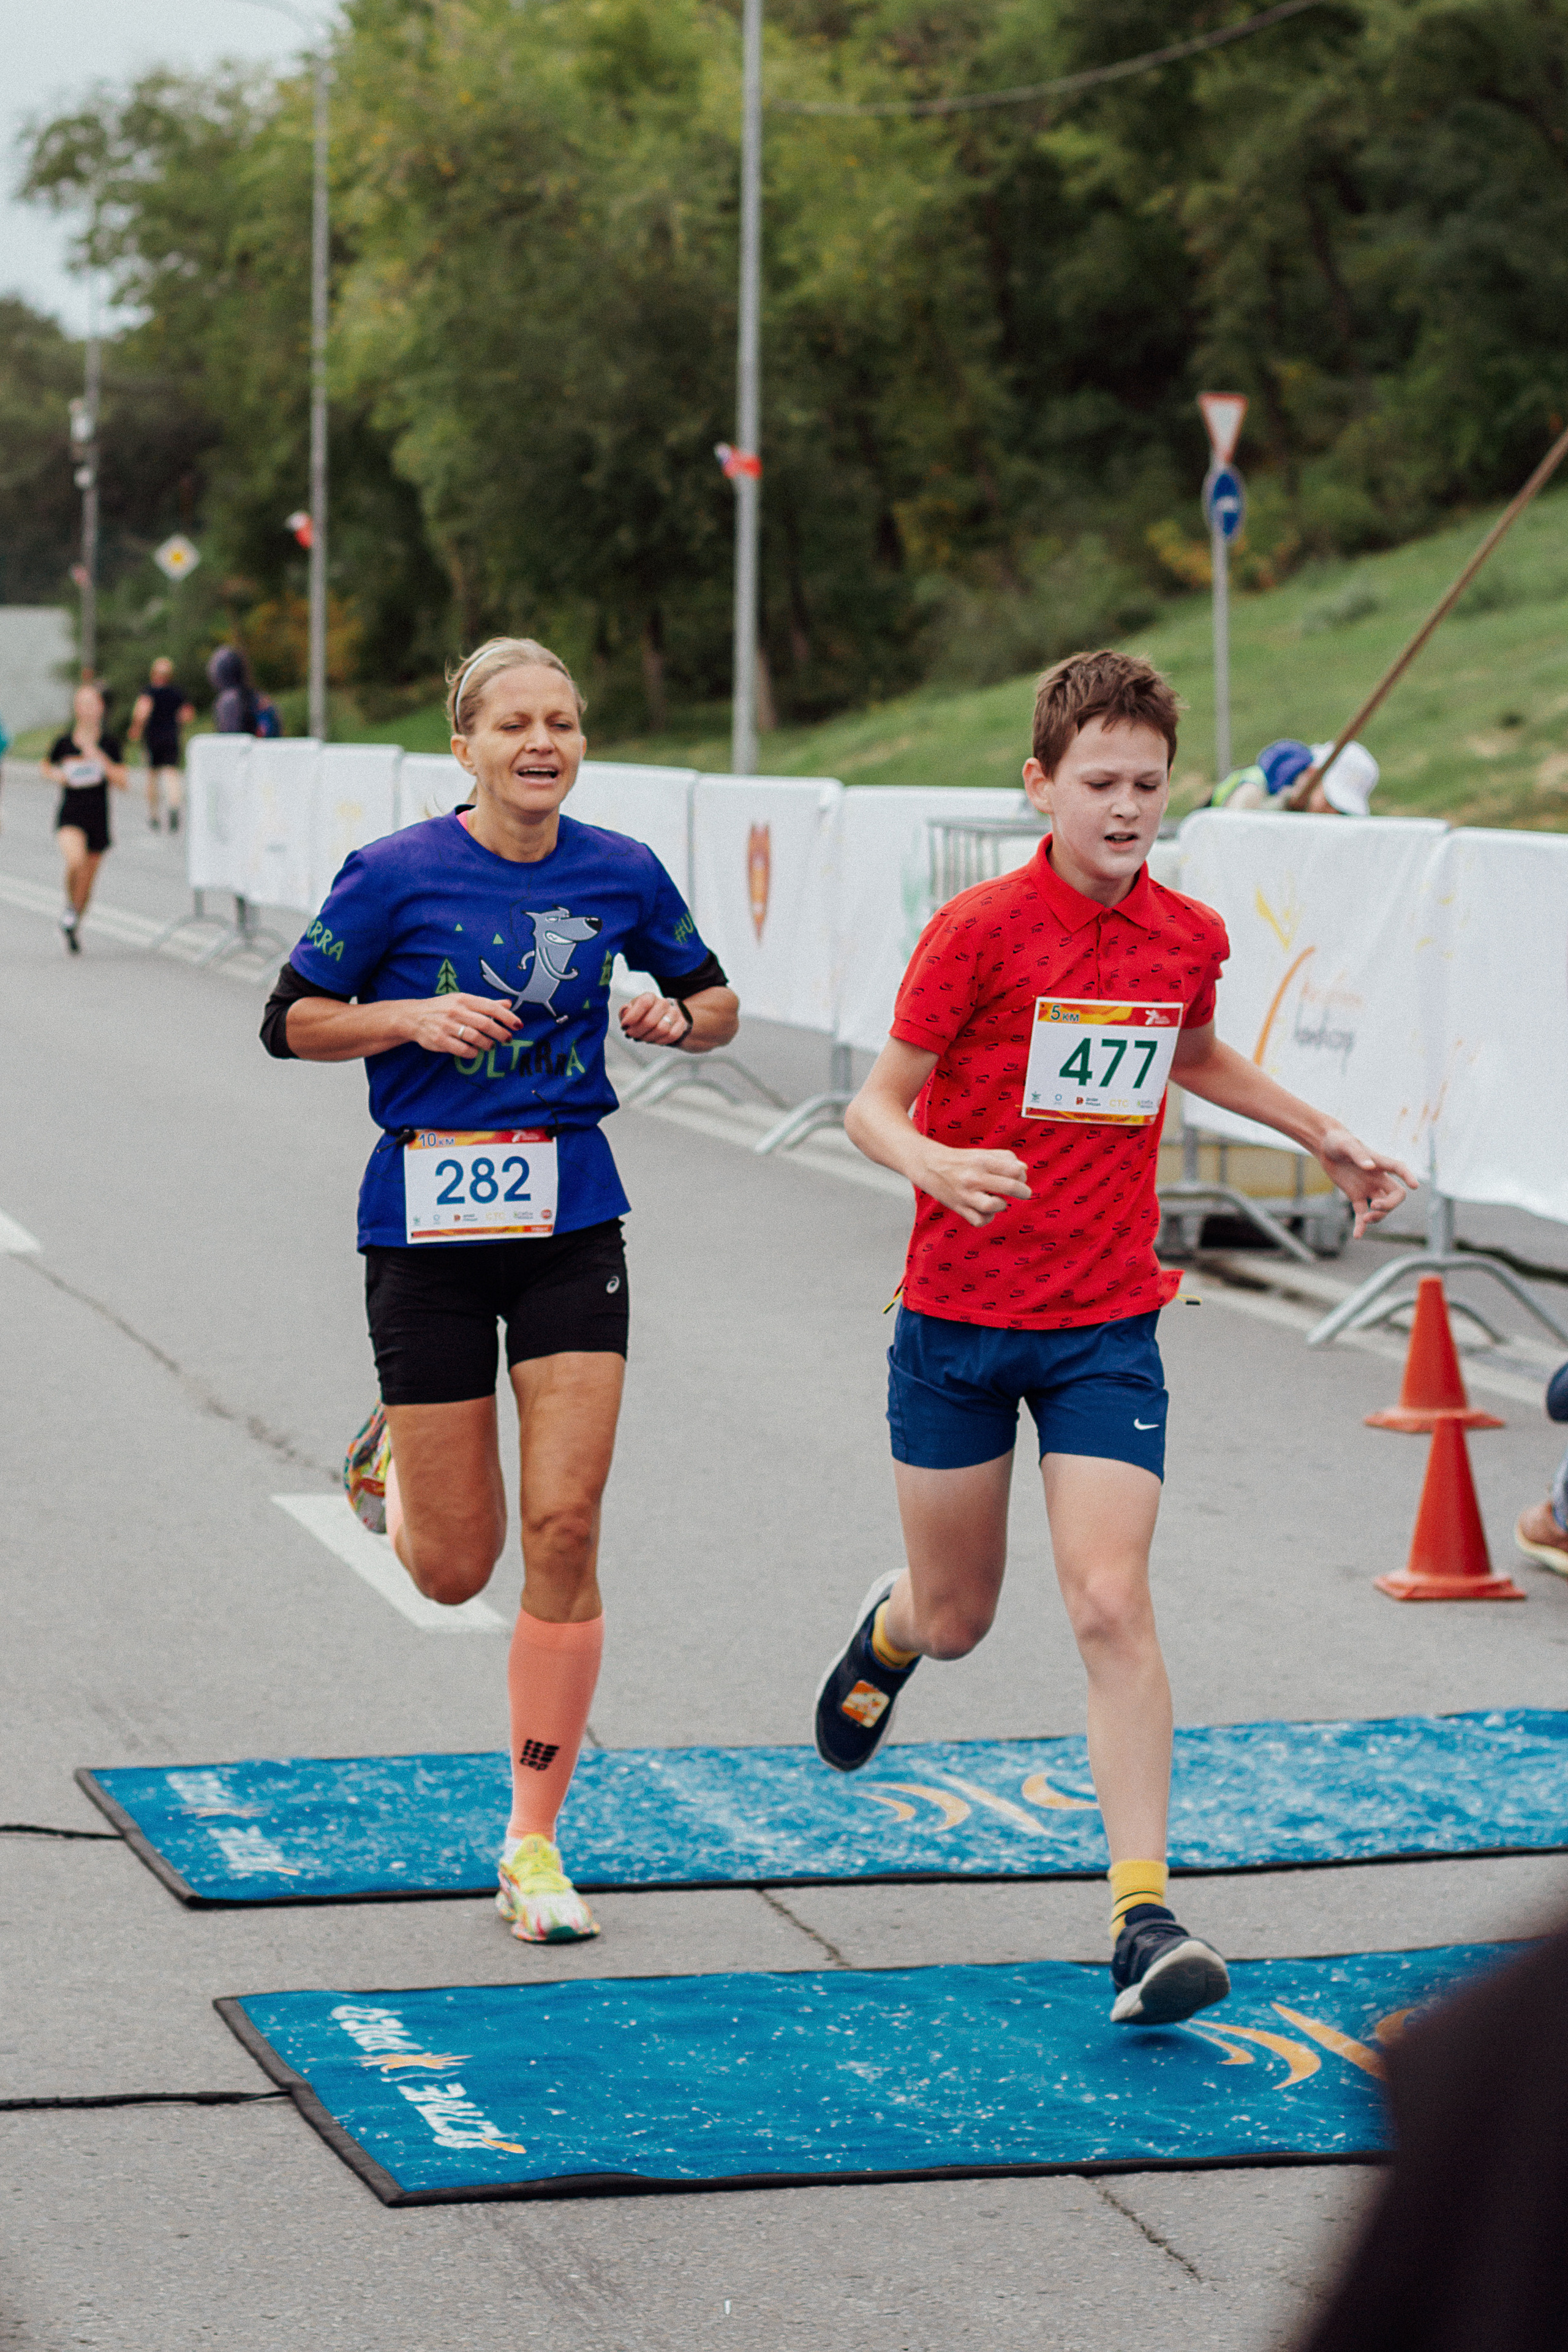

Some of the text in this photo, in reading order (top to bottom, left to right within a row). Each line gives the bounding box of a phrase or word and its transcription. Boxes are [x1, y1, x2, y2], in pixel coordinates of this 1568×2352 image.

[1050, 1005, 1061, 1020] 5
[1058, 1038, 1158, 1089] 477
[418, 1133, 437, 1148] 10
[435, 1156, 531, 1205] 282
